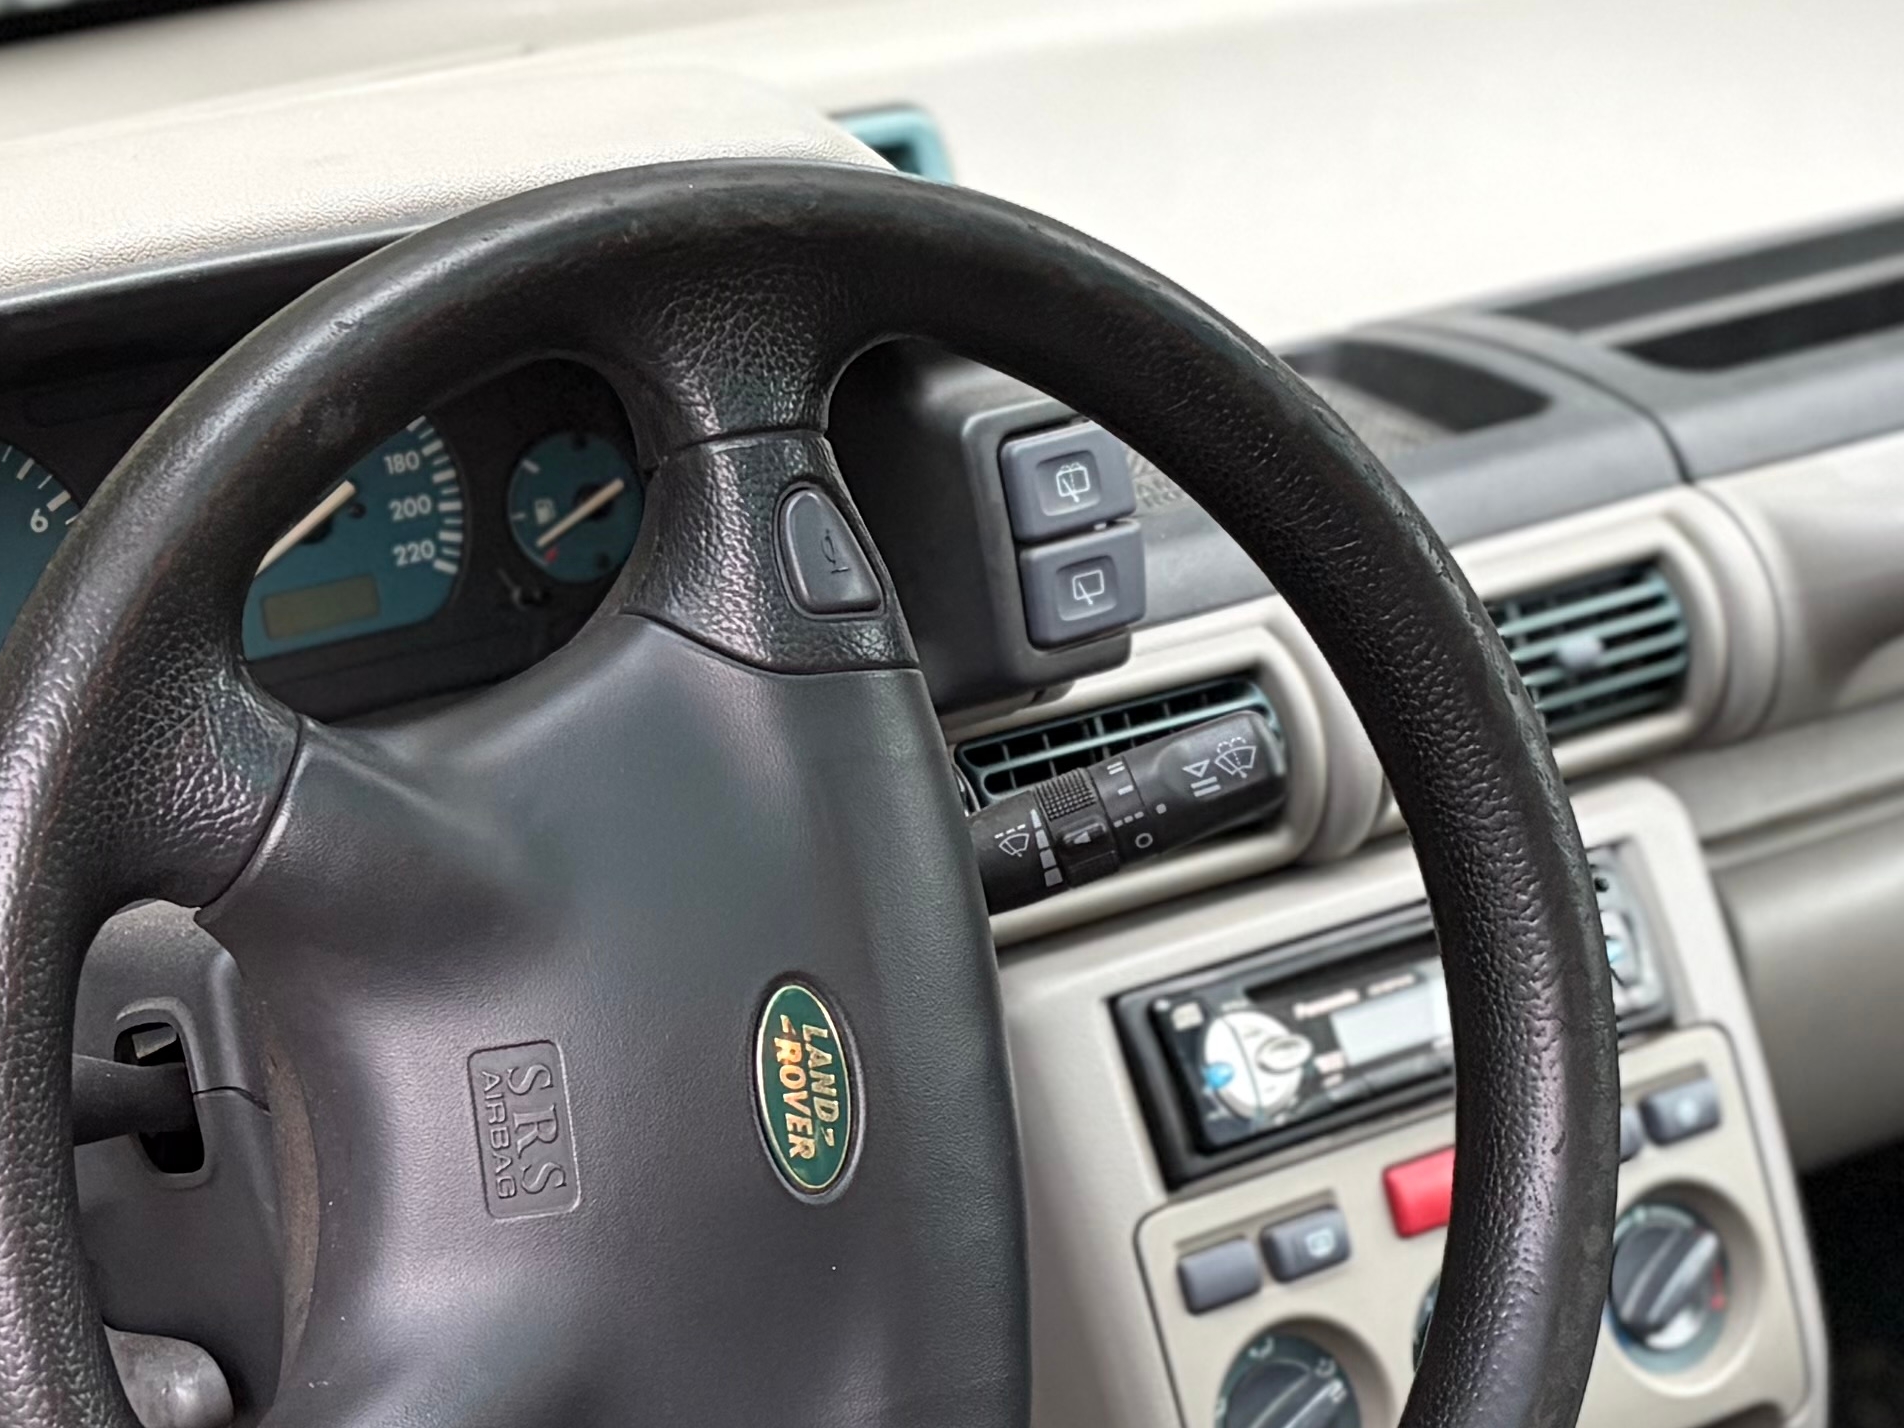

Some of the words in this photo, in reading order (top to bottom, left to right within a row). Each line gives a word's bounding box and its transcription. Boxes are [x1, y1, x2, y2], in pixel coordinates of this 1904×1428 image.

[382, 449, 422, 474] 180
[29, 507, 49, 534] 6
[387, 494, 433, 523] 200
[391, 539, 437, 567] 220
[774, 1036, 817, 1160] ROVER
[801, 1023, 841, 1125] LAND
[481, 1070, 518, 1200] AIRBAG
[507, 1062, 567, 1196] SRS
